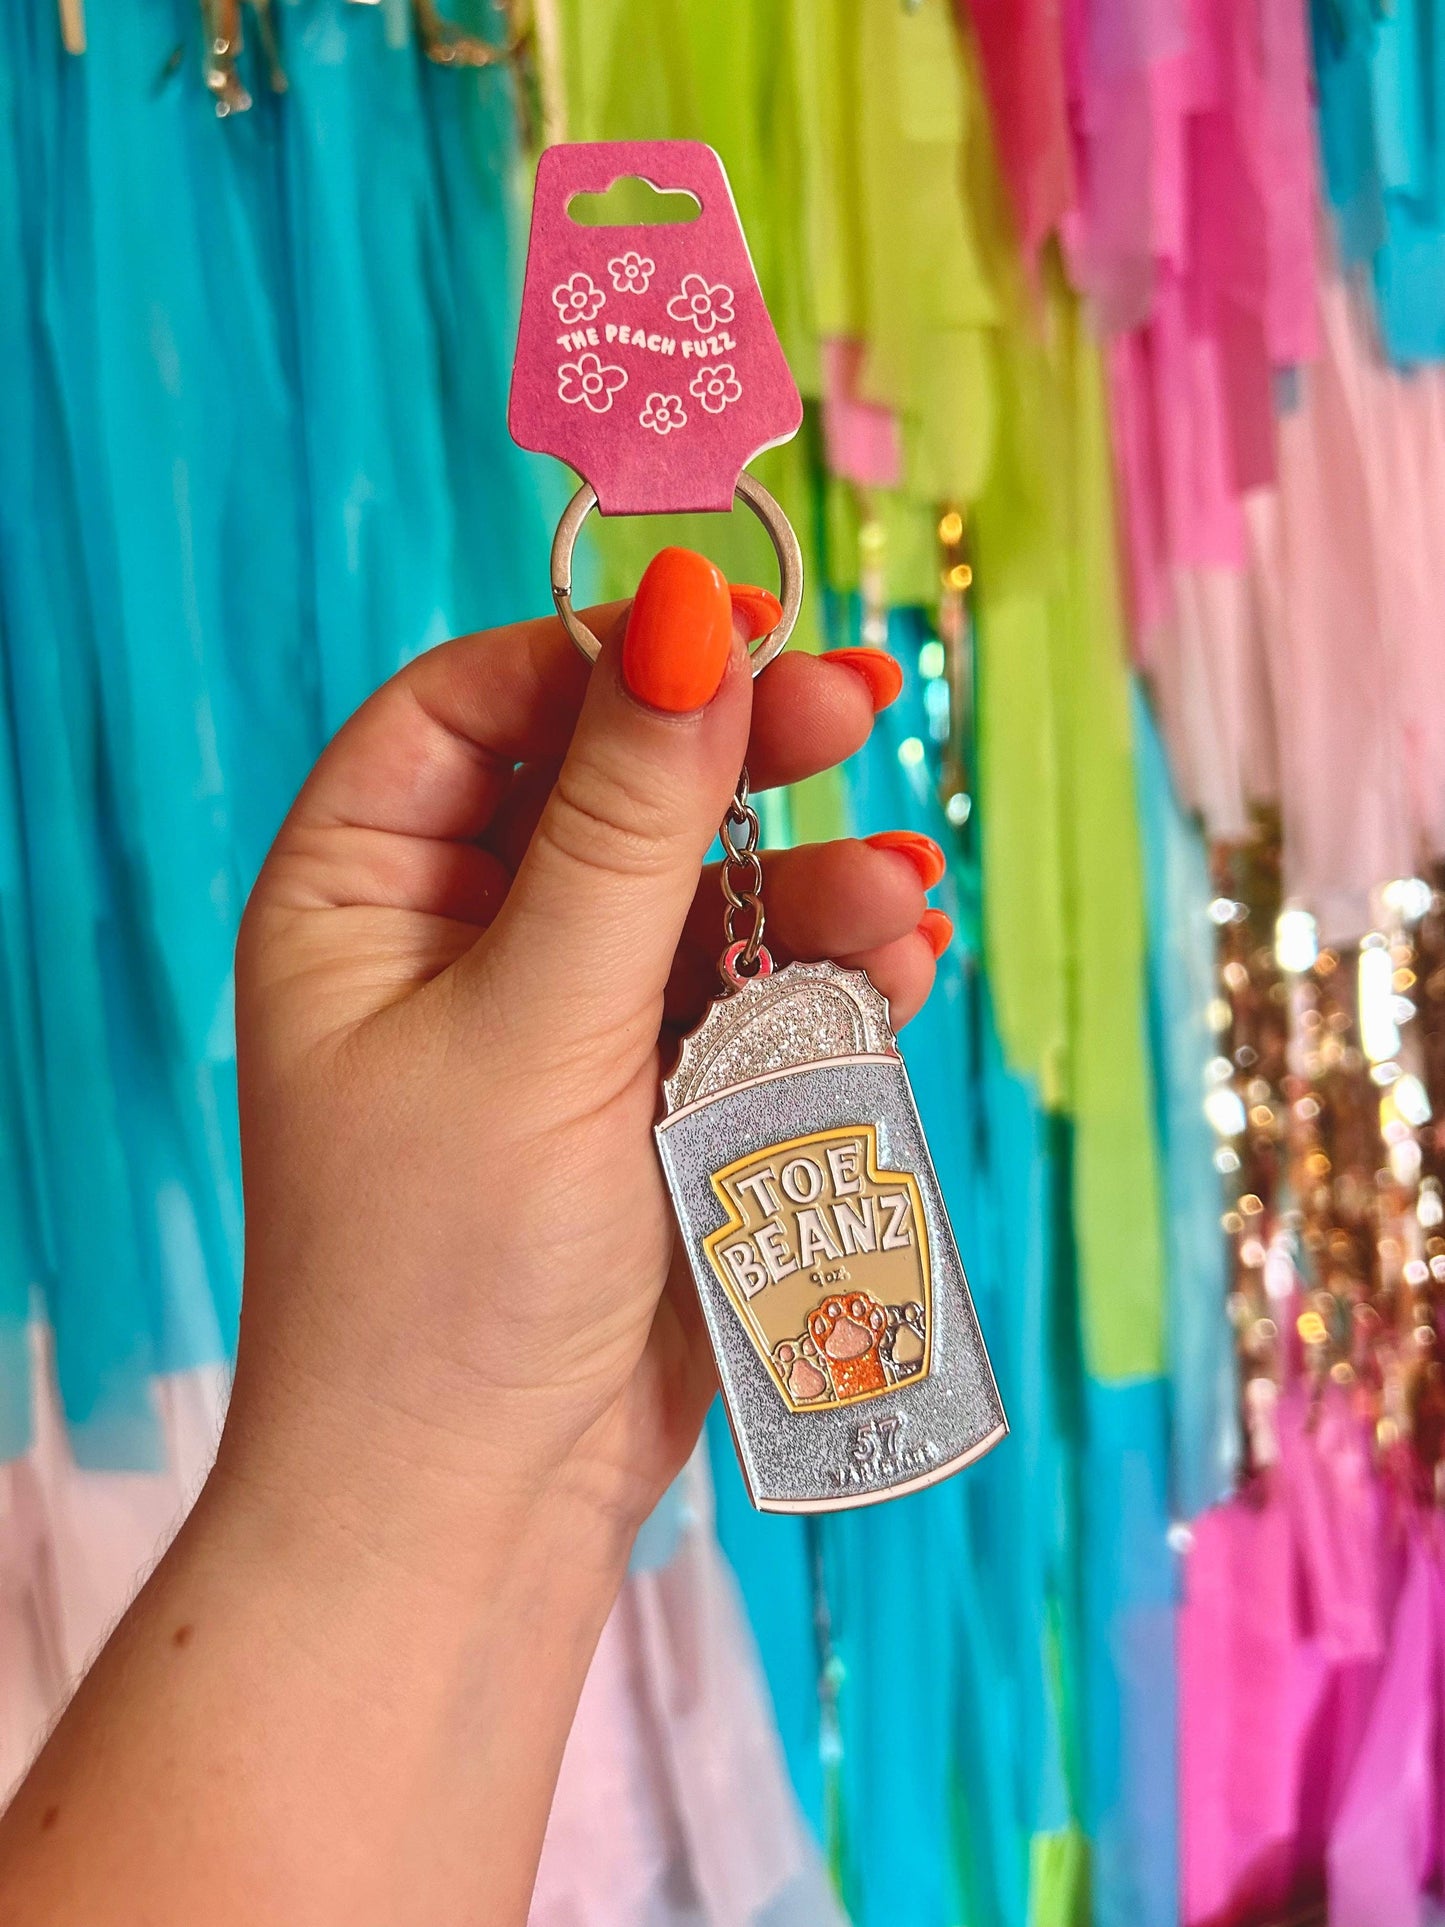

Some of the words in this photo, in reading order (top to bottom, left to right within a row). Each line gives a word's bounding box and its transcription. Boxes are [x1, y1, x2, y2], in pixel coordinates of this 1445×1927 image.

[556, 328, 600, 353] THE
[604, 323, 676, 356] PEACH
[681, 331, 737, 359] FUZZ
[735, 1144, 862, 1217] TOE
[721, 1194, 912, 1301] BEANZ
[852, 1416, 899, 1462] 57
